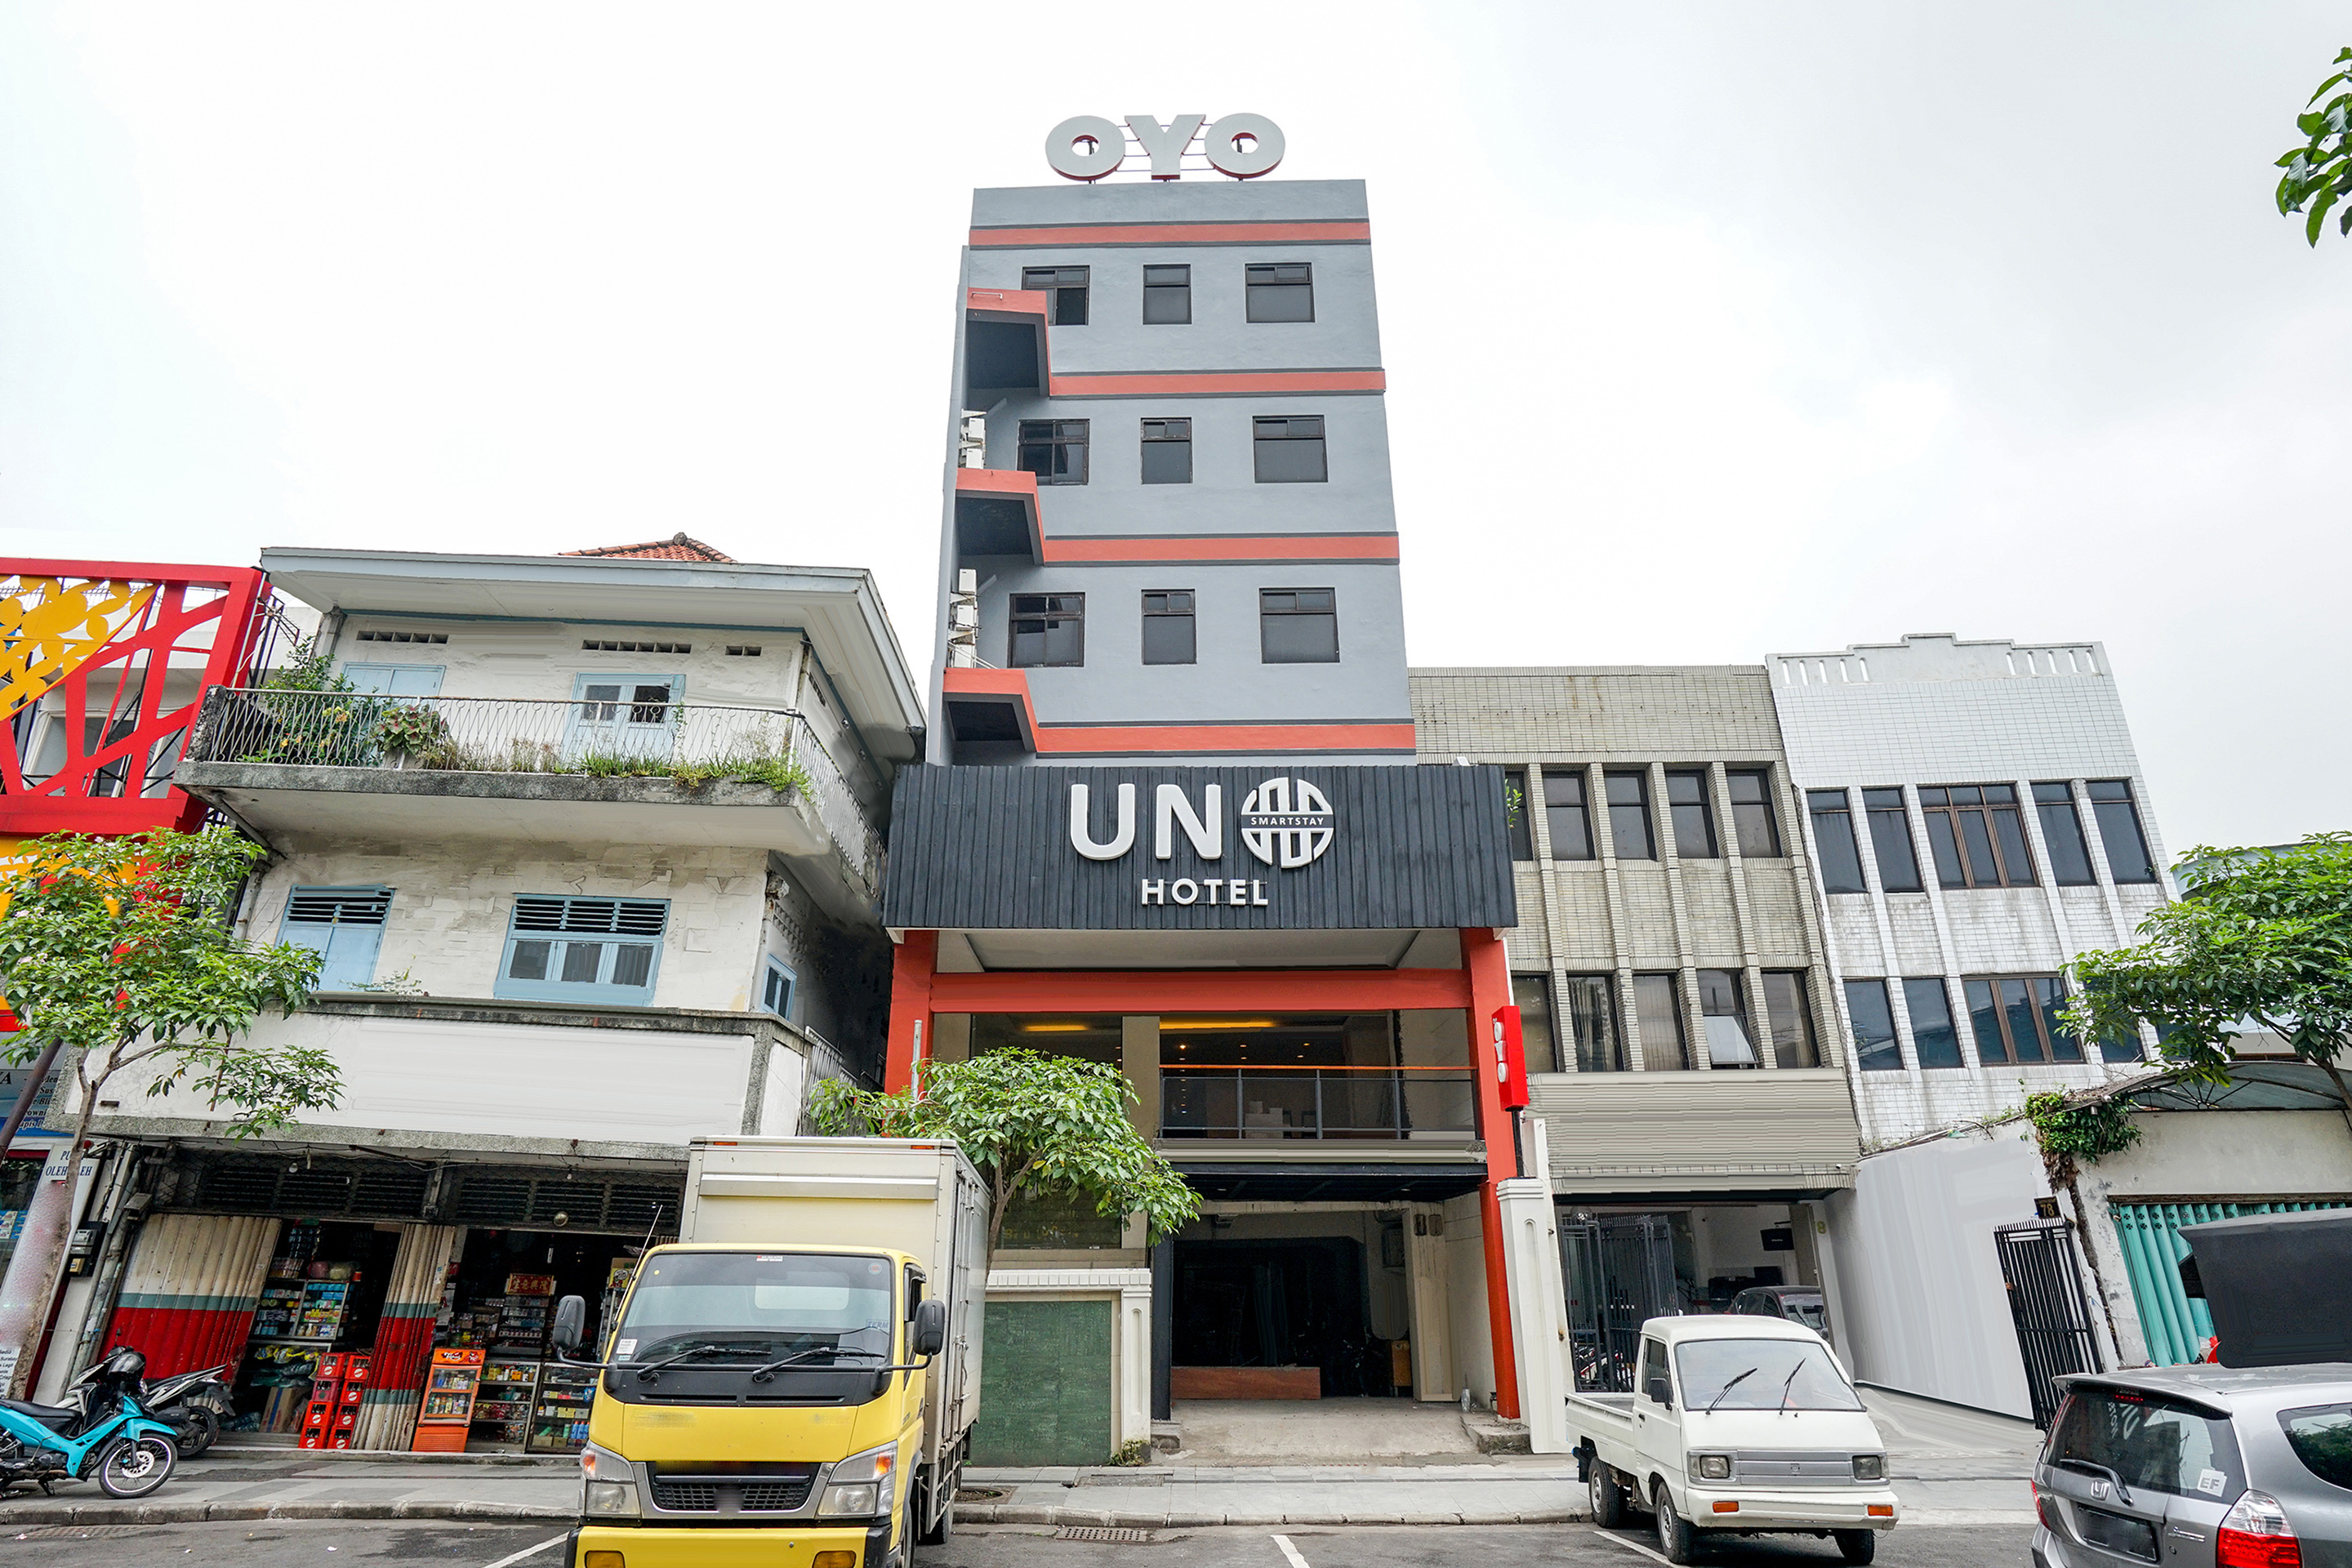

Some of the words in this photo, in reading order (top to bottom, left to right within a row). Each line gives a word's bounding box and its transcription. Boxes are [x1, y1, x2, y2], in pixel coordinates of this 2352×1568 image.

[1045, 113, 1286, 181] OYO
[1250, 817, 1324, 826] SMARTSTAY
[1142, 878, 1268, 906] HOTEL
[2040, 1203, 2055, 1217] 78
